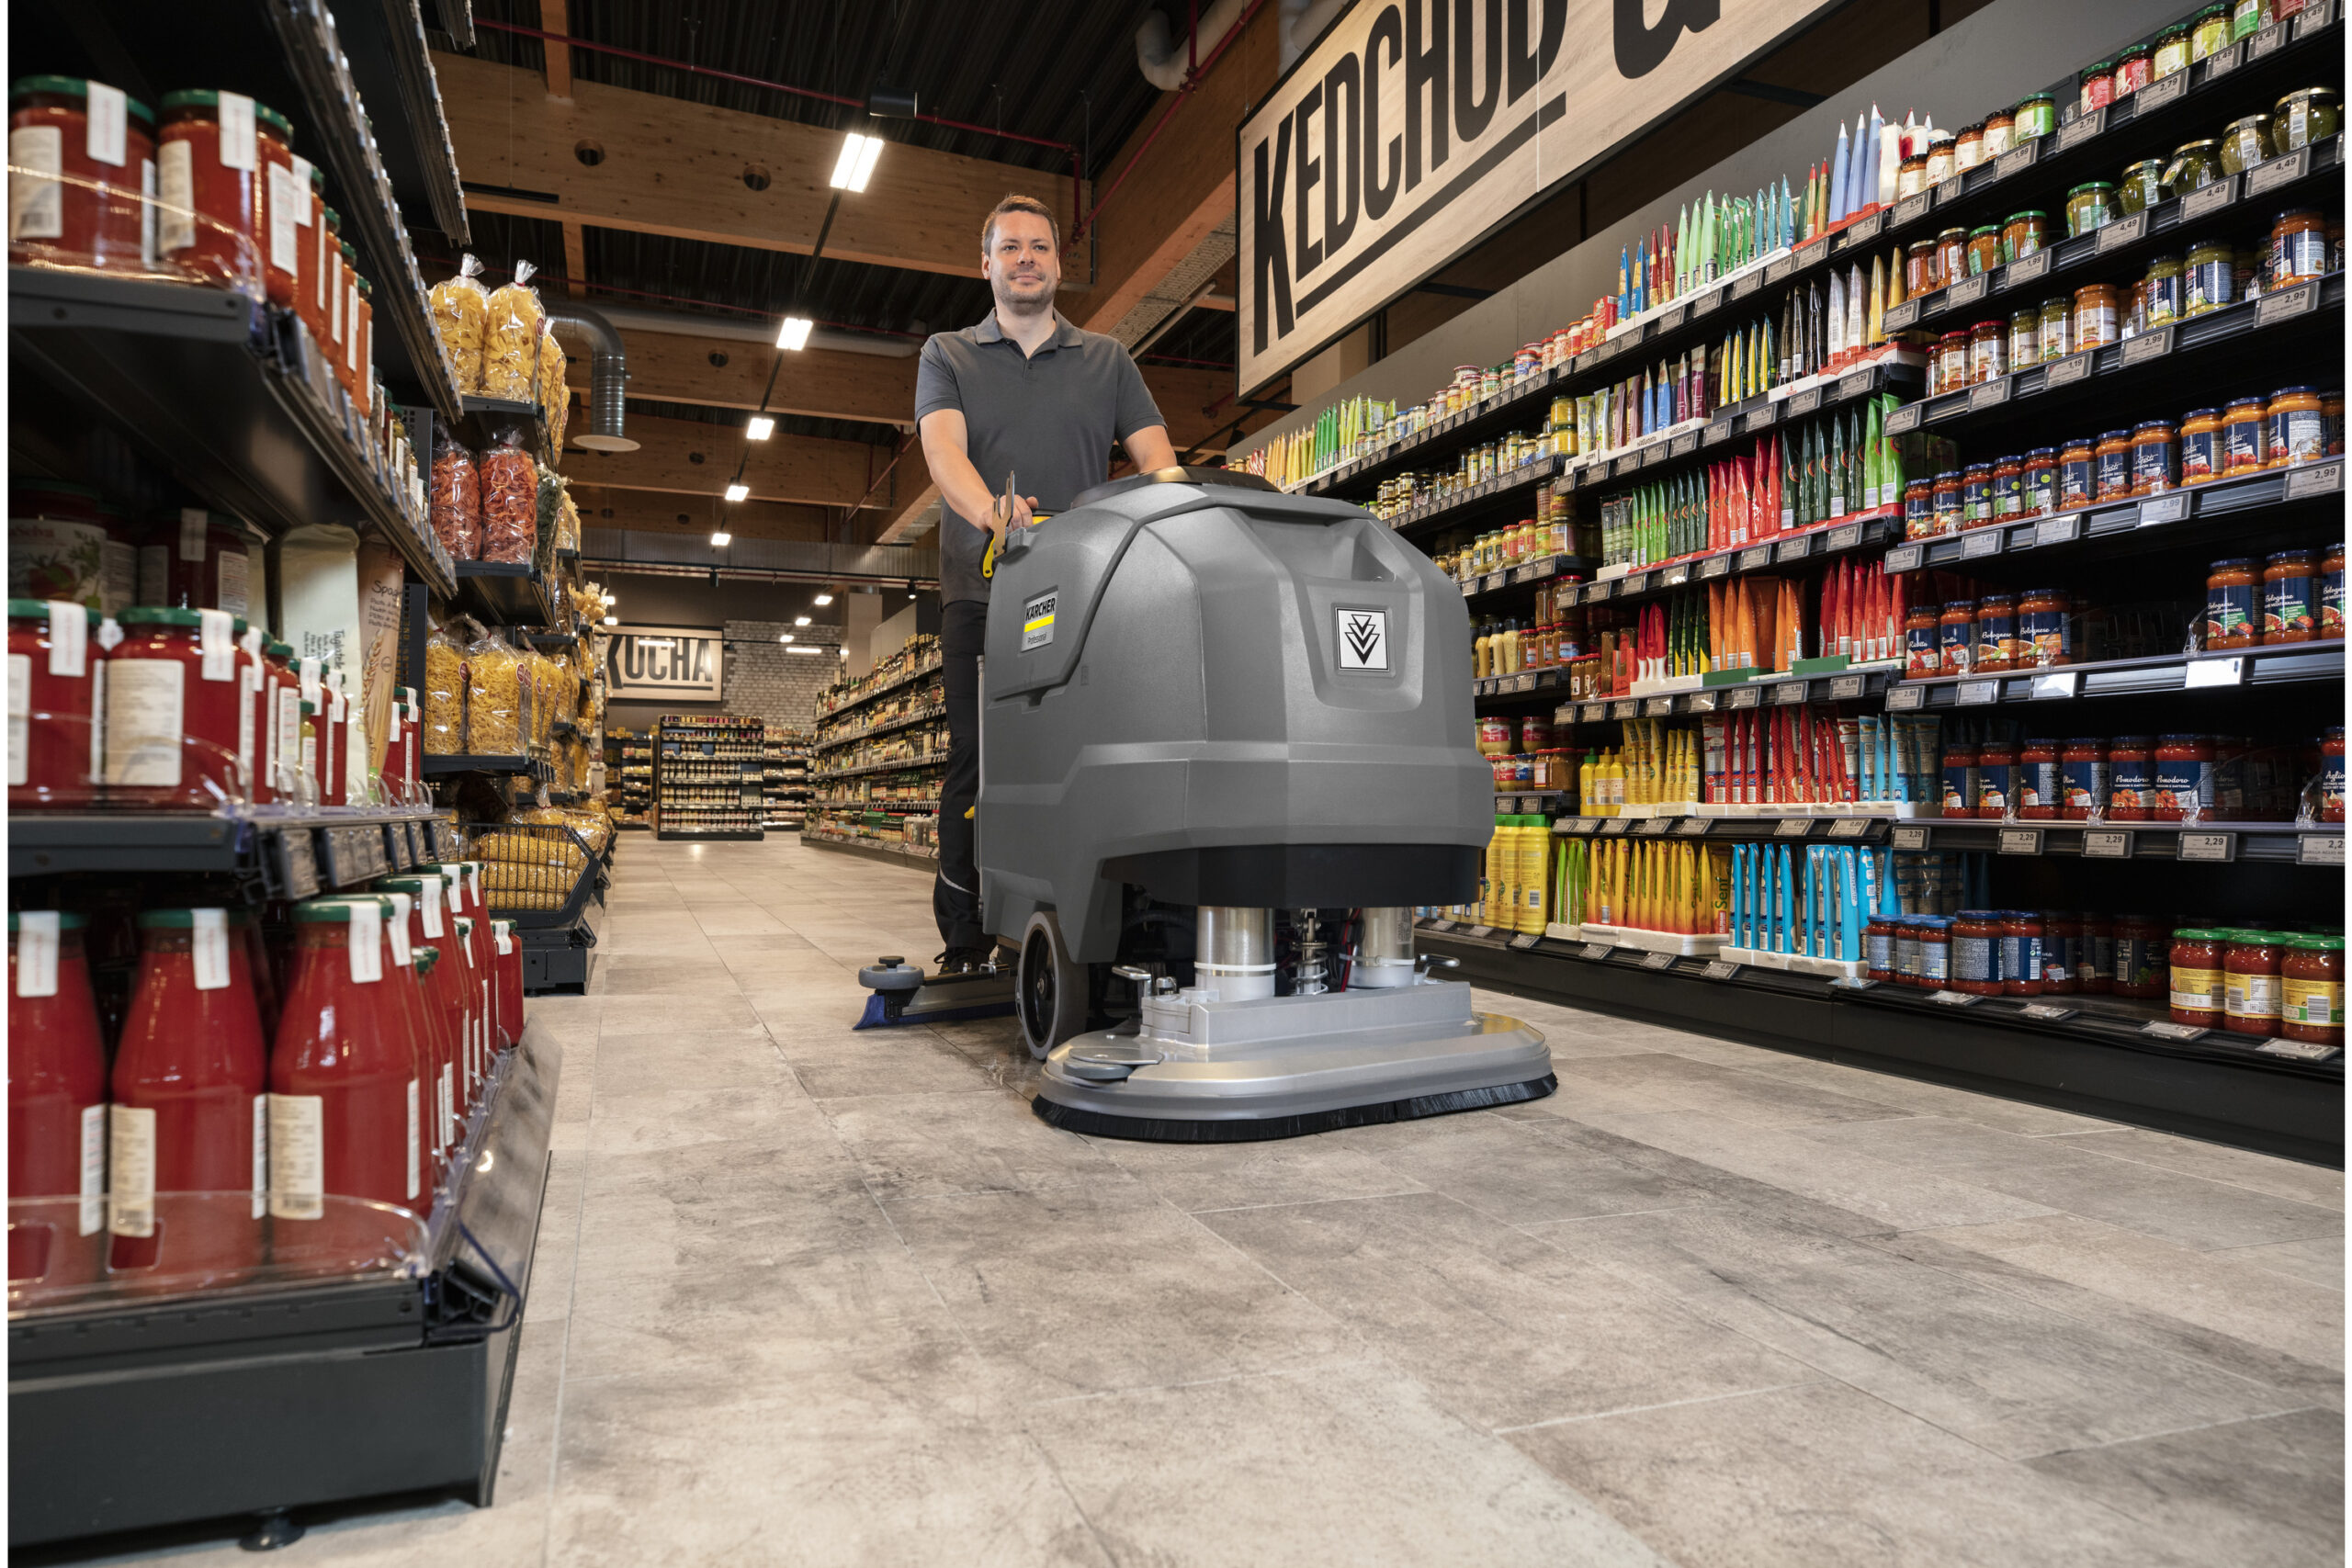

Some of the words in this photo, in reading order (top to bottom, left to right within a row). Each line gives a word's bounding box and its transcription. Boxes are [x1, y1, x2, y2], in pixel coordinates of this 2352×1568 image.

[2256, 28, 2277, 42] 4,49
[2214, 50, 2233, 62] 4,49
[2159, 77, 2177, 92] 2,79
[2078, 116, 2096, 130] 2,79
[2275, 156, 2296, 171] 4,49
[2207, 185, 2226, 197] 4,49
[2120, 219, 2137, 231] 4,49
[2027, 255, 2041, 266] 1,99
[1966, 280, 1979, 290] 1,99
[2284, 290, 2306, 304] 2,99
[1899, 307, 1912, 316] 2,99
[2144, 334, 2163, 345] 2,99
[2068, 359, 2083, 369] 1,19
[1990, 382, 2003, 392] 1,19
[1902, 410, 1914, 420] 1,19
[2314, 467, 2336, 479] 2,99
[2161, 498, 2180, 510] 2,99
[1982, 630, 2012, 640] Bolognese
[2020, 626, 2050, 636] Bolognese
[1908, 640, 1928, 649] Ricotta
[2157, 775, 2189, 784] Pomodoro
[1909, 830, 1922, 839] 2,29
[2019, 833, 2034, 841] 2,29
[2105, 835, 2123, 844] 2,29
[2205, 837, 2224, 847] 2,29
[2328, 840, 2345, 849] 2,2
[1715, 876, 1727, 909] Senf
